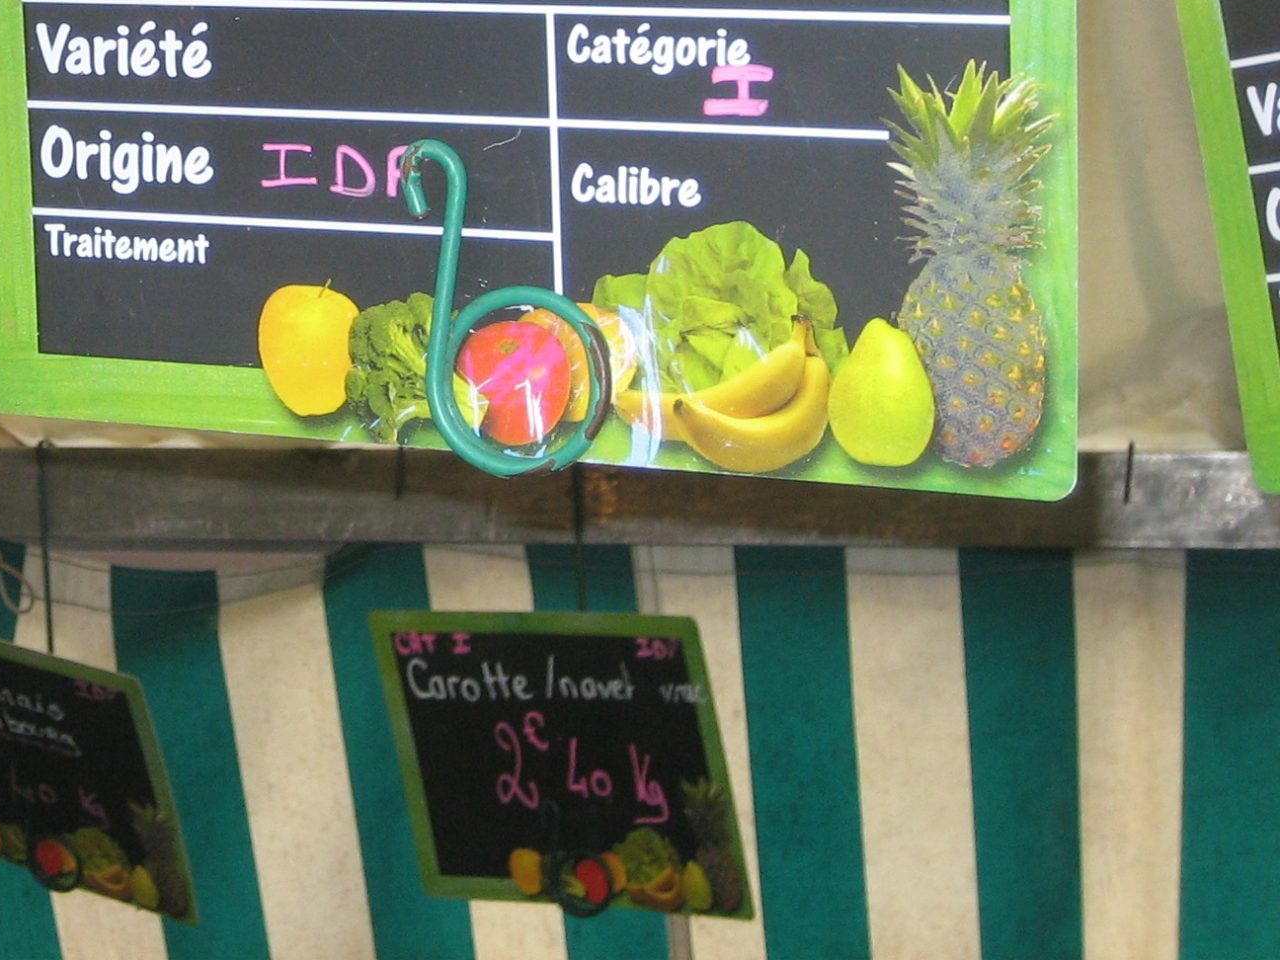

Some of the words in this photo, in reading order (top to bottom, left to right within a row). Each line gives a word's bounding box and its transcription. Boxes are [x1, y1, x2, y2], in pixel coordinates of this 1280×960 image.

[35, 20, 213, 80] Variété
[567, 23, 751, 75] Catégorie
[40, 125, 214, 190] Origine
[571, 162, 701, 207] Calibre
[44, 222, 209, 265] Traitement
